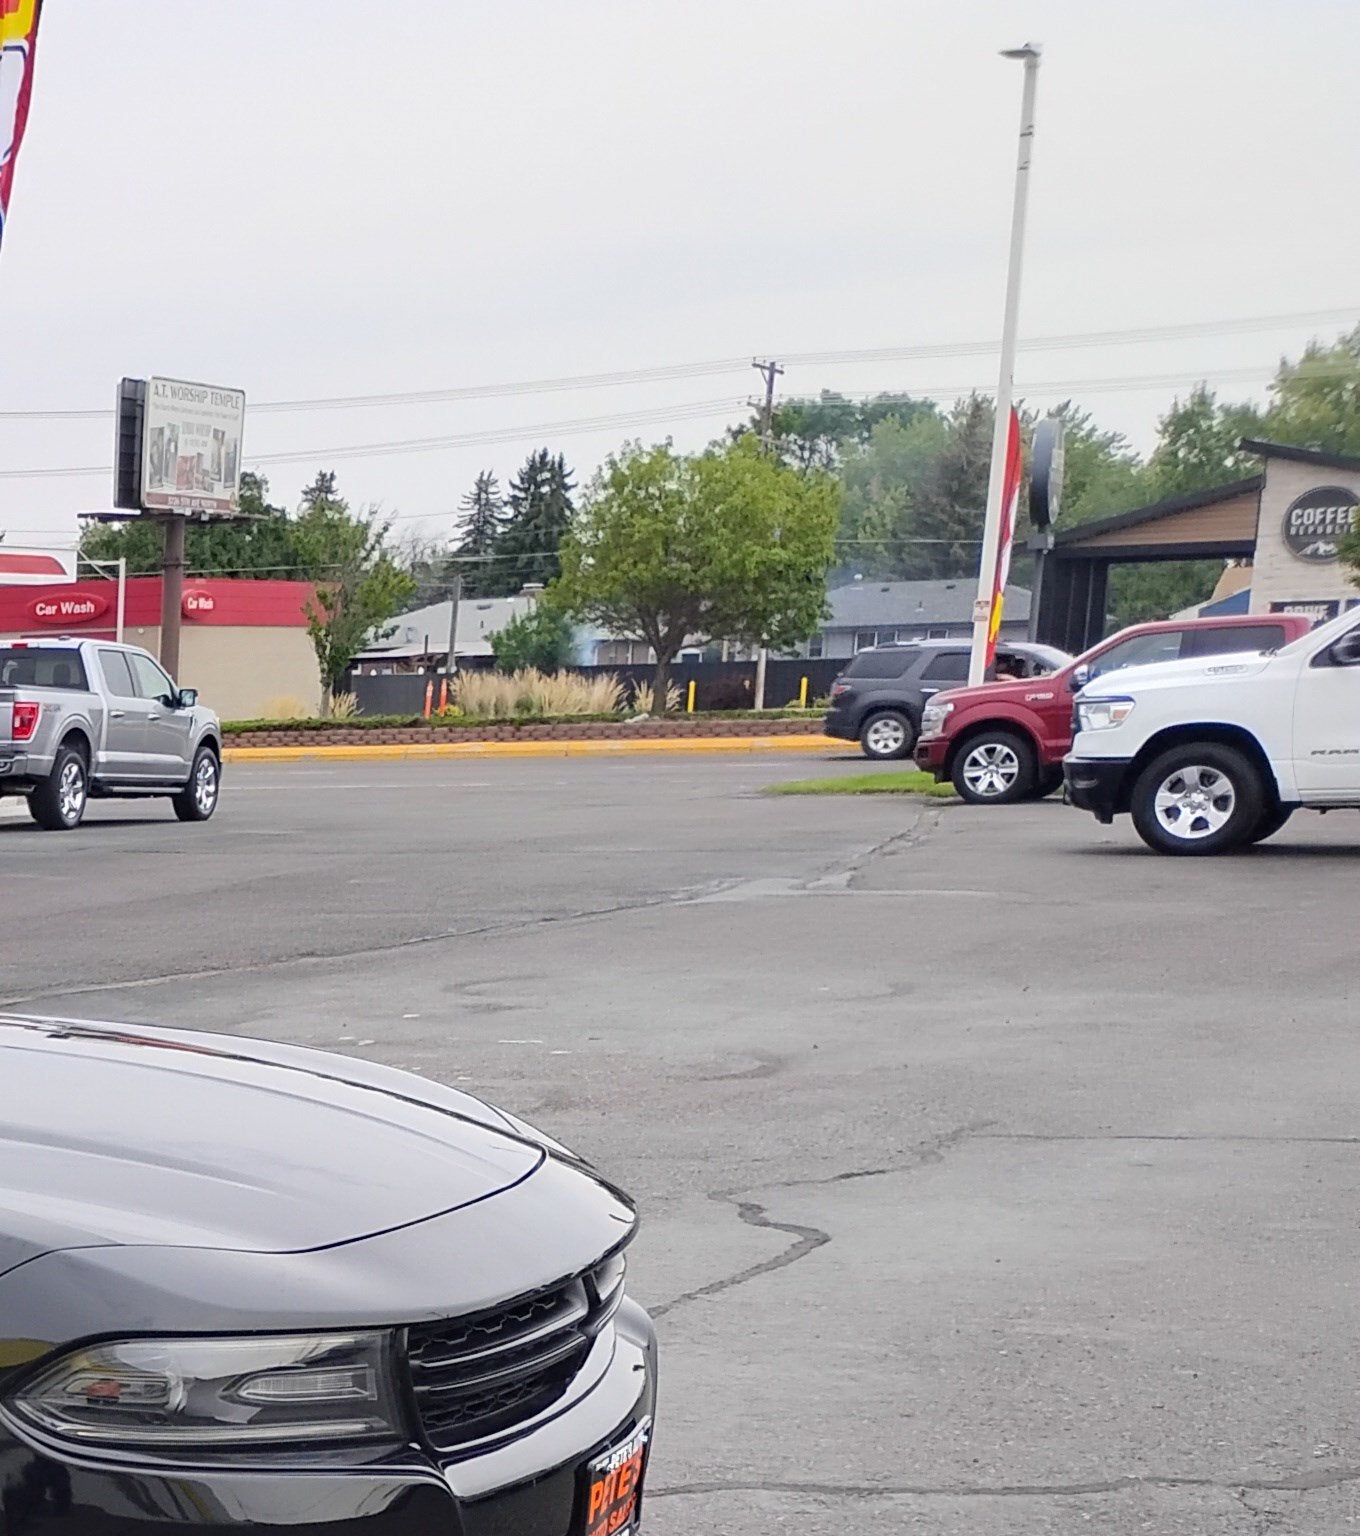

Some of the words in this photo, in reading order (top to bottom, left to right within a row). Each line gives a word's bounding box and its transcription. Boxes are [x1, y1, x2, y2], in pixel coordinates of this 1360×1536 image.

[170, 385, 208, 404] WORSHIP
[210, 392, 240, 410] TEMPLE
[36, 602, 57, 616] Car
[60, 602, 95, 615] Wash
